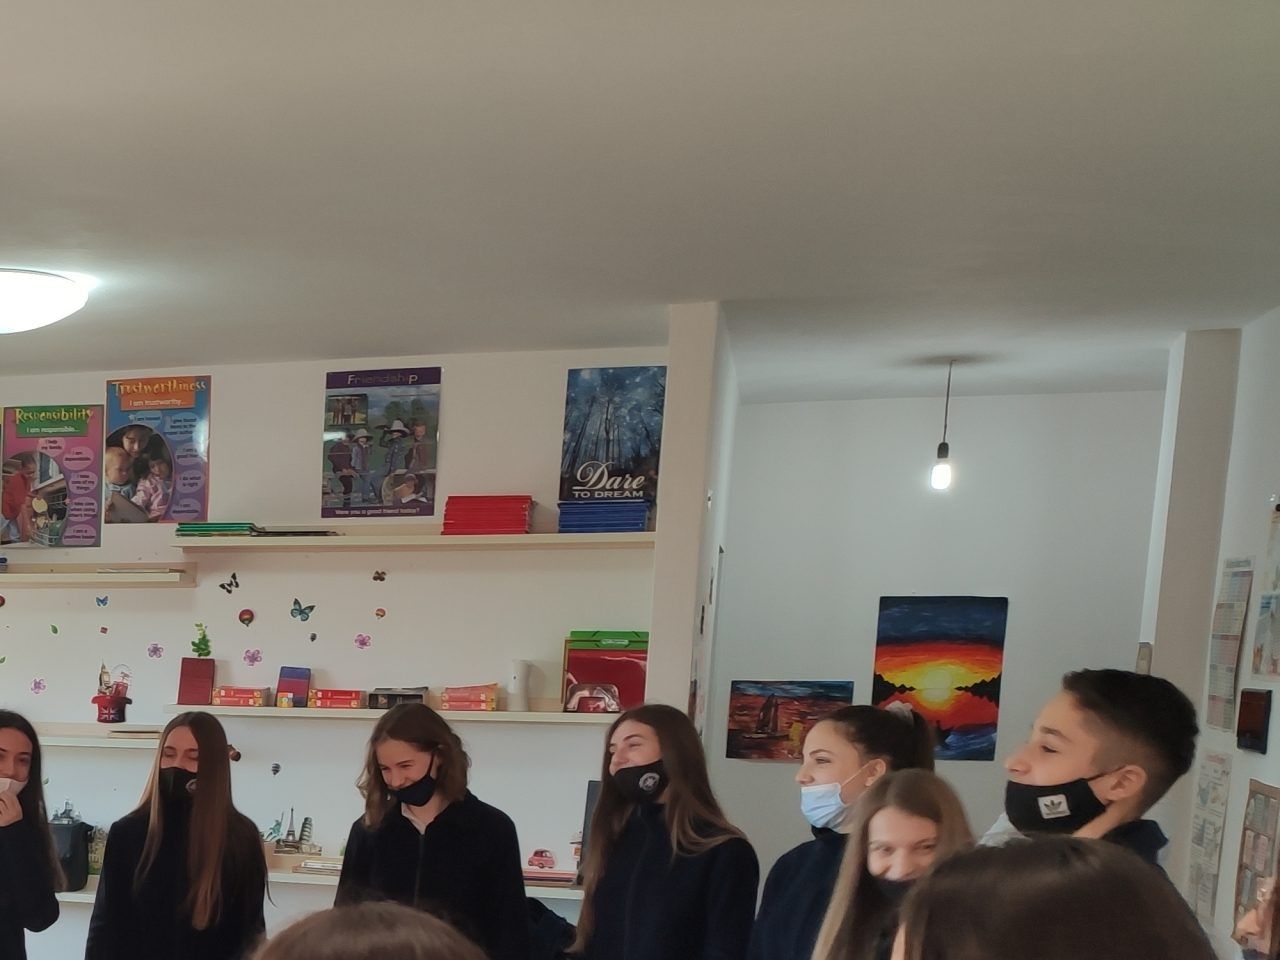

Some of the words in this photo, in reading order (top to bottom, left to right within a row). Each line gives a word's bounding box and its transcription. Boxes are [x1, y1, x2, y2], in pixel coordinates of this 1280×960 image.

[14, 408, 94, 425] Responsibility
[572, 460, 646, 490] Dare
[594, 490, 644, 498] DREAM
